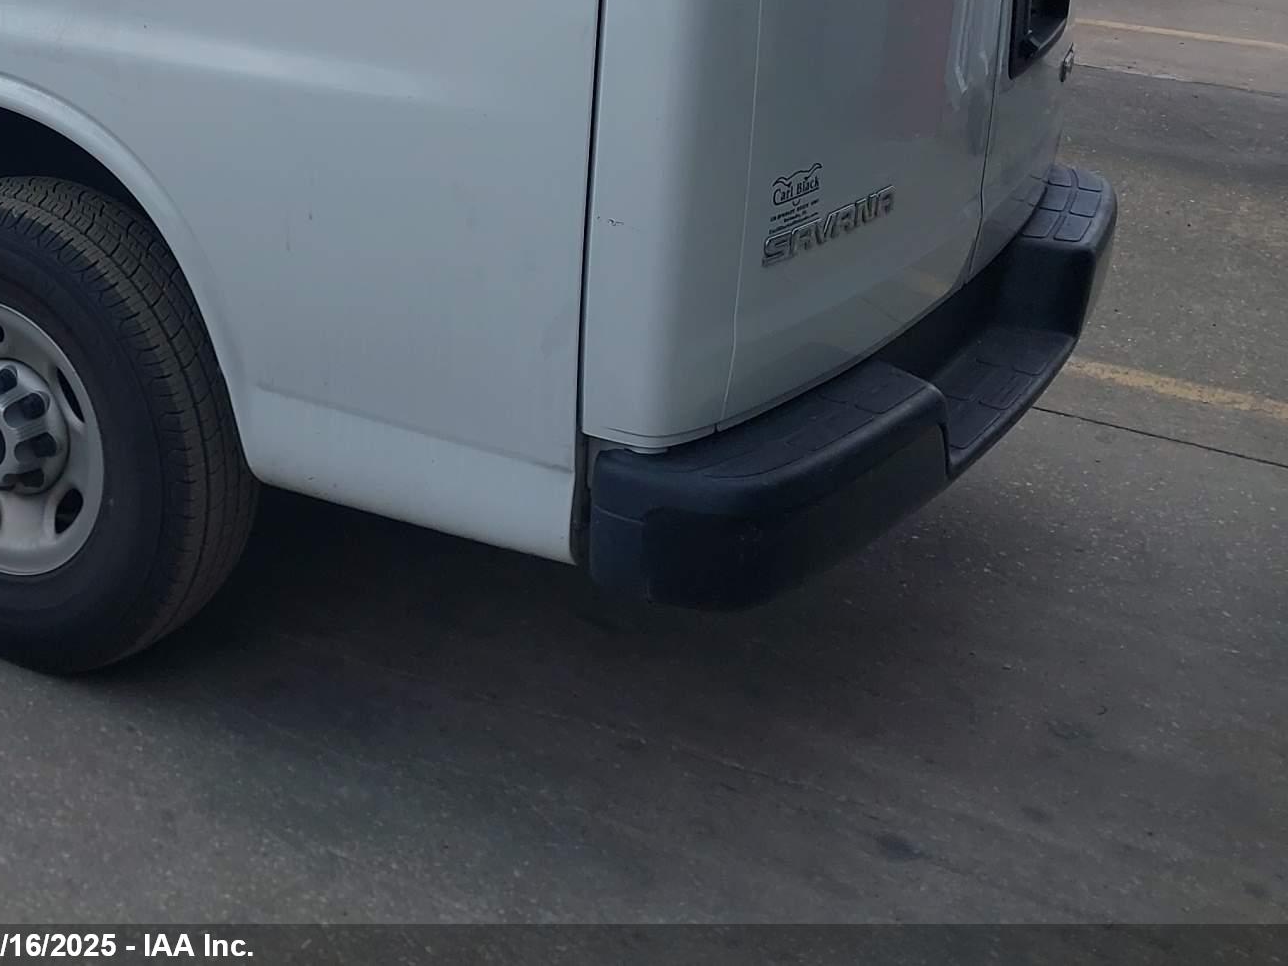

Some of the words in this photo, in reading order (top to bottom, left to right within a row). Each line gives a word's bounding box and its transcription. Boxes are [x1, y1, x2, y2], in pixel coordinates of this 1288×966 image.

[773, 185, 793, 206] Carl
[796, 176, 820, 194] Black
[762, 184, 896, 267] SAVANA
